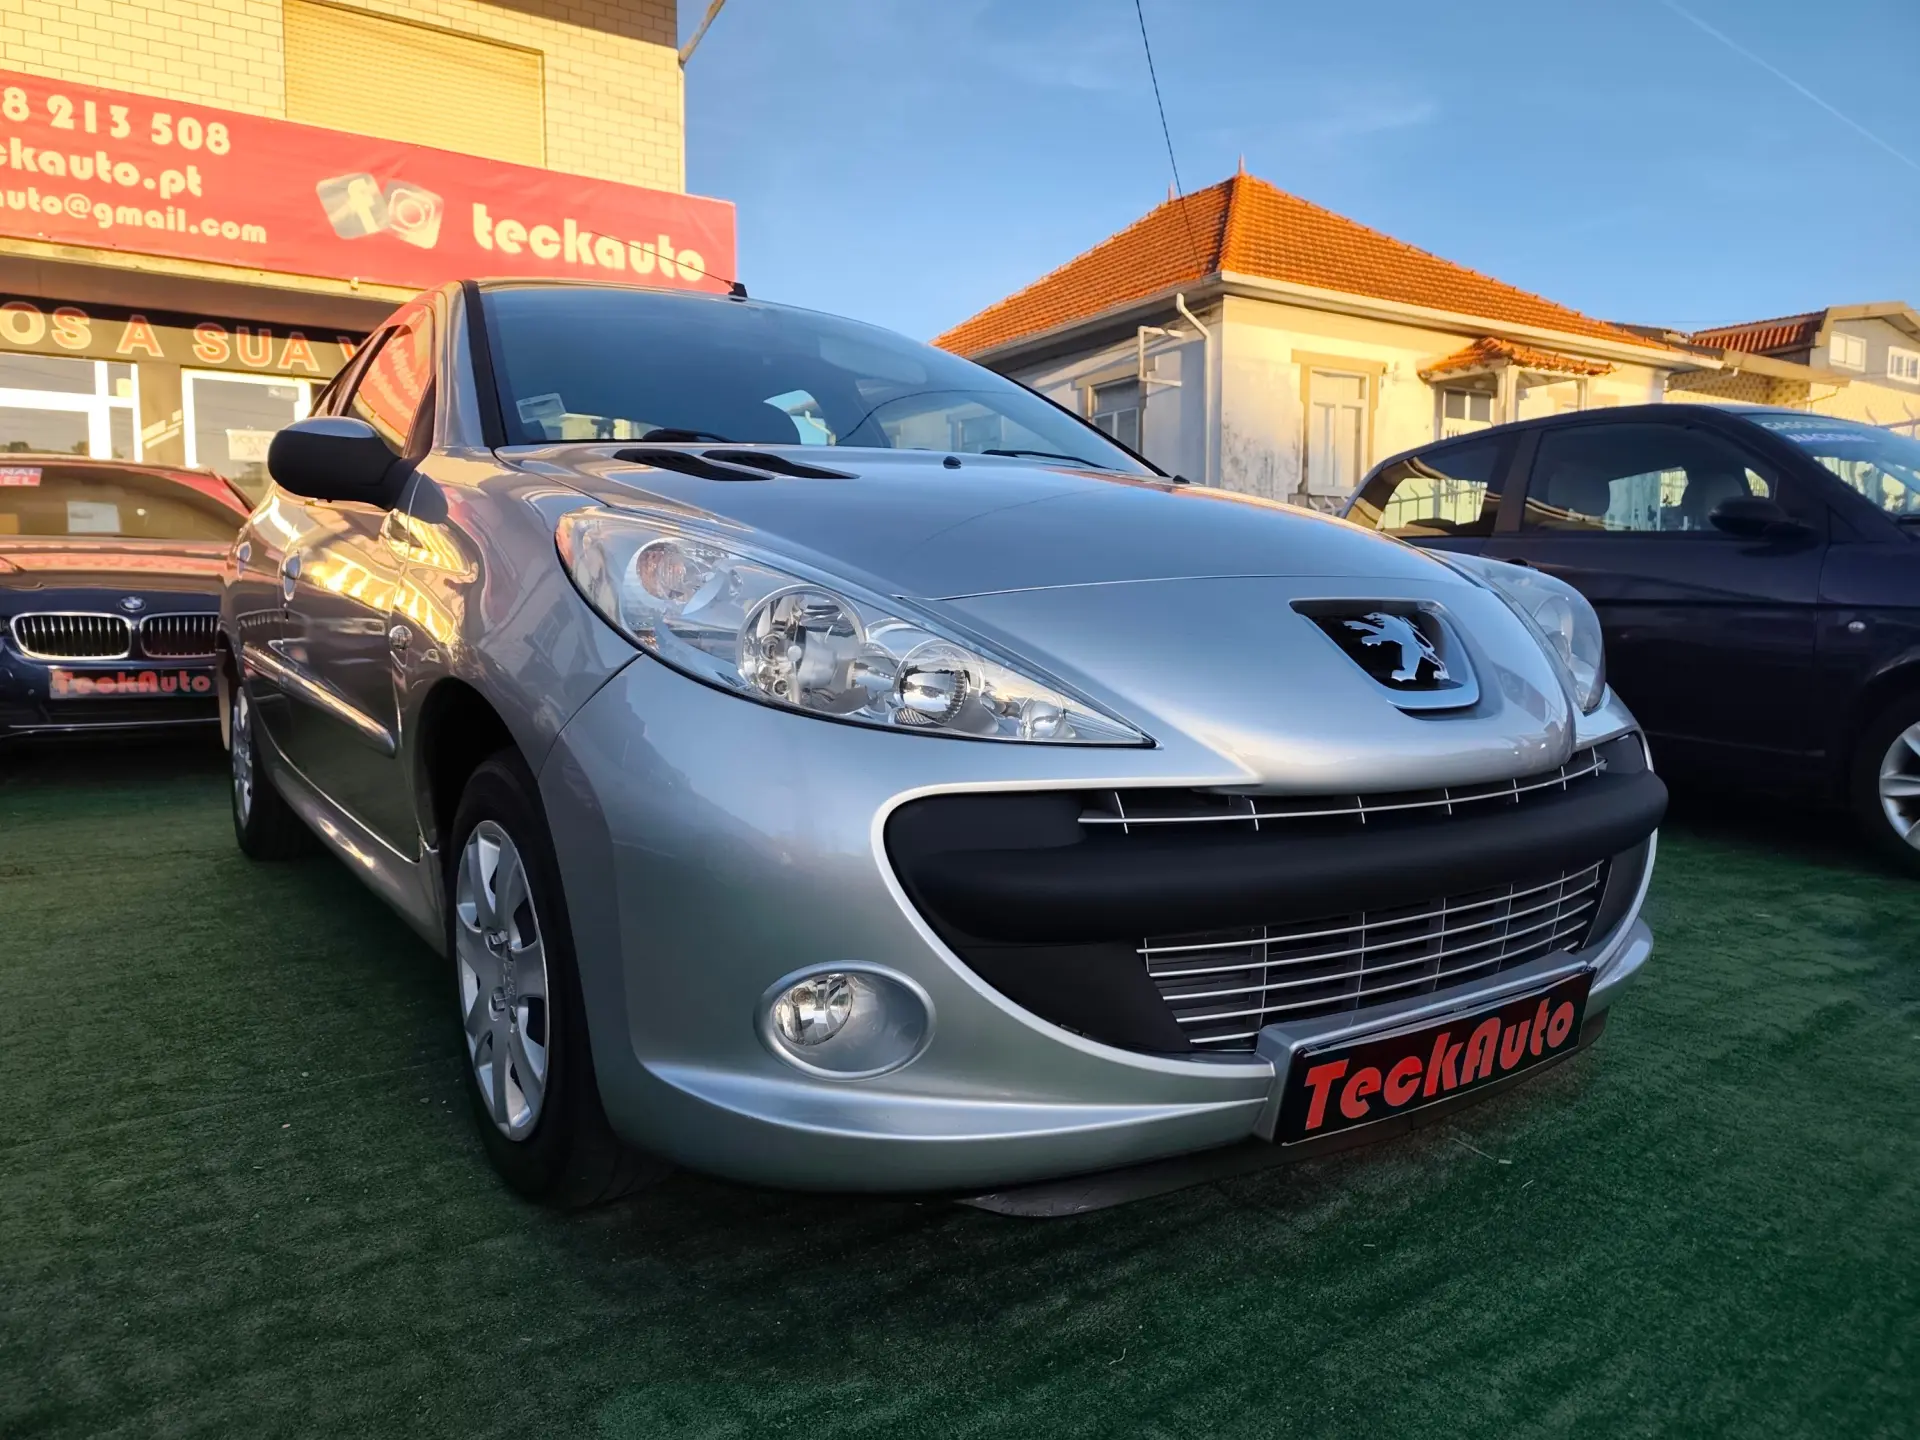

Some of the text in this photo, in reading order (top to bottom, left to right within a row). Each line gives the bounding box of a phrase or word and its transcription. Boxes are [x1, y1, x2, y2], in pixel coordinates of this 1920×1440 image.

[2, 86, 231, 155] 8 213 508
[0, 186, 267, 244] uto@gmail.com
[472, 203, 706, 282] teckauto
[117, 314, 165, 357] A
[192, 322, 320, 372] SUA
[51, 670, 211, 695] TeckAuto
[1303, 996, 1575, 1131] TeckAuto
